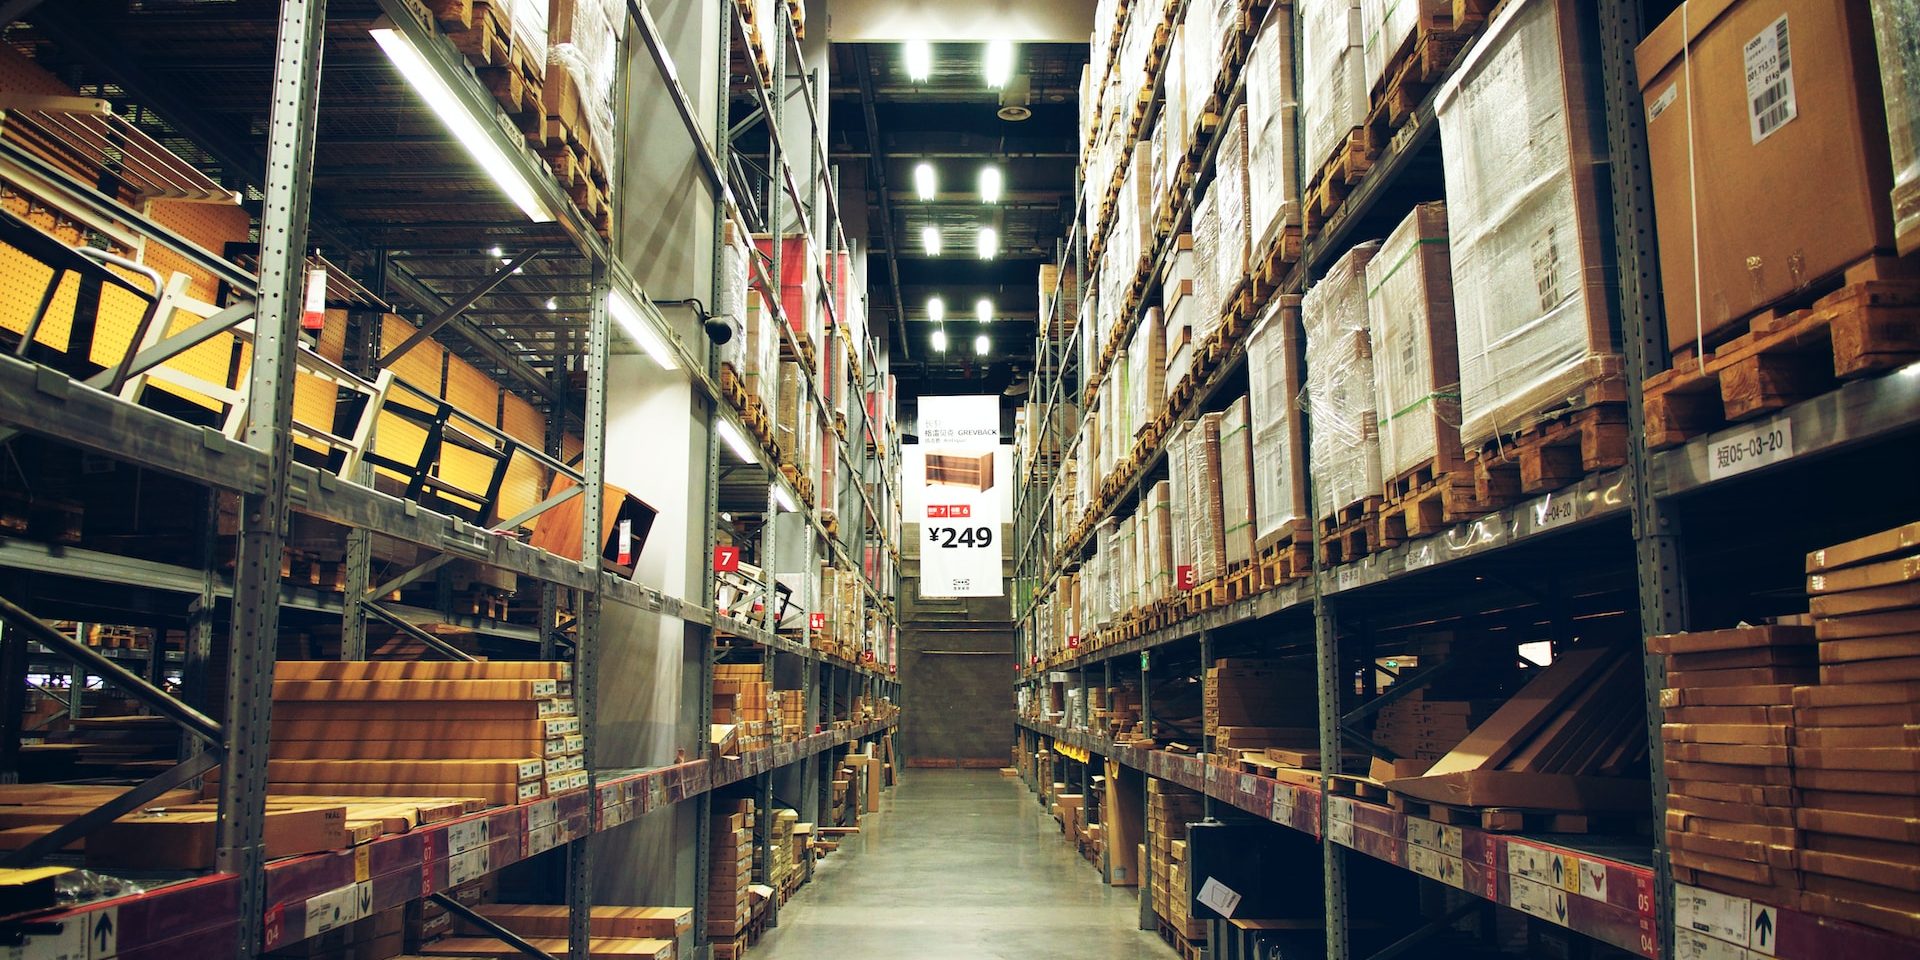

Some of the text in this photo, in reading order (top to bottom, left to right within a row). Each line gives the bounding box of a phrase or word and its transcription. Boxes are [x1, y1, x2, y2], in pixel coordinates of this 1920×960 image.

[1717, 430, 1783, 469] 短05-03-20
[928, 527, 992, 548] ¥249
[721, 551, 733, 566] 7
[1185, 570, 1192, 584] 5
[1071, 637, 1078, 646] 5
[1638, 893, 1649, 912] 05
[266, 924, 279, 945] 04
[1640, 934, 1653, 954] 04
